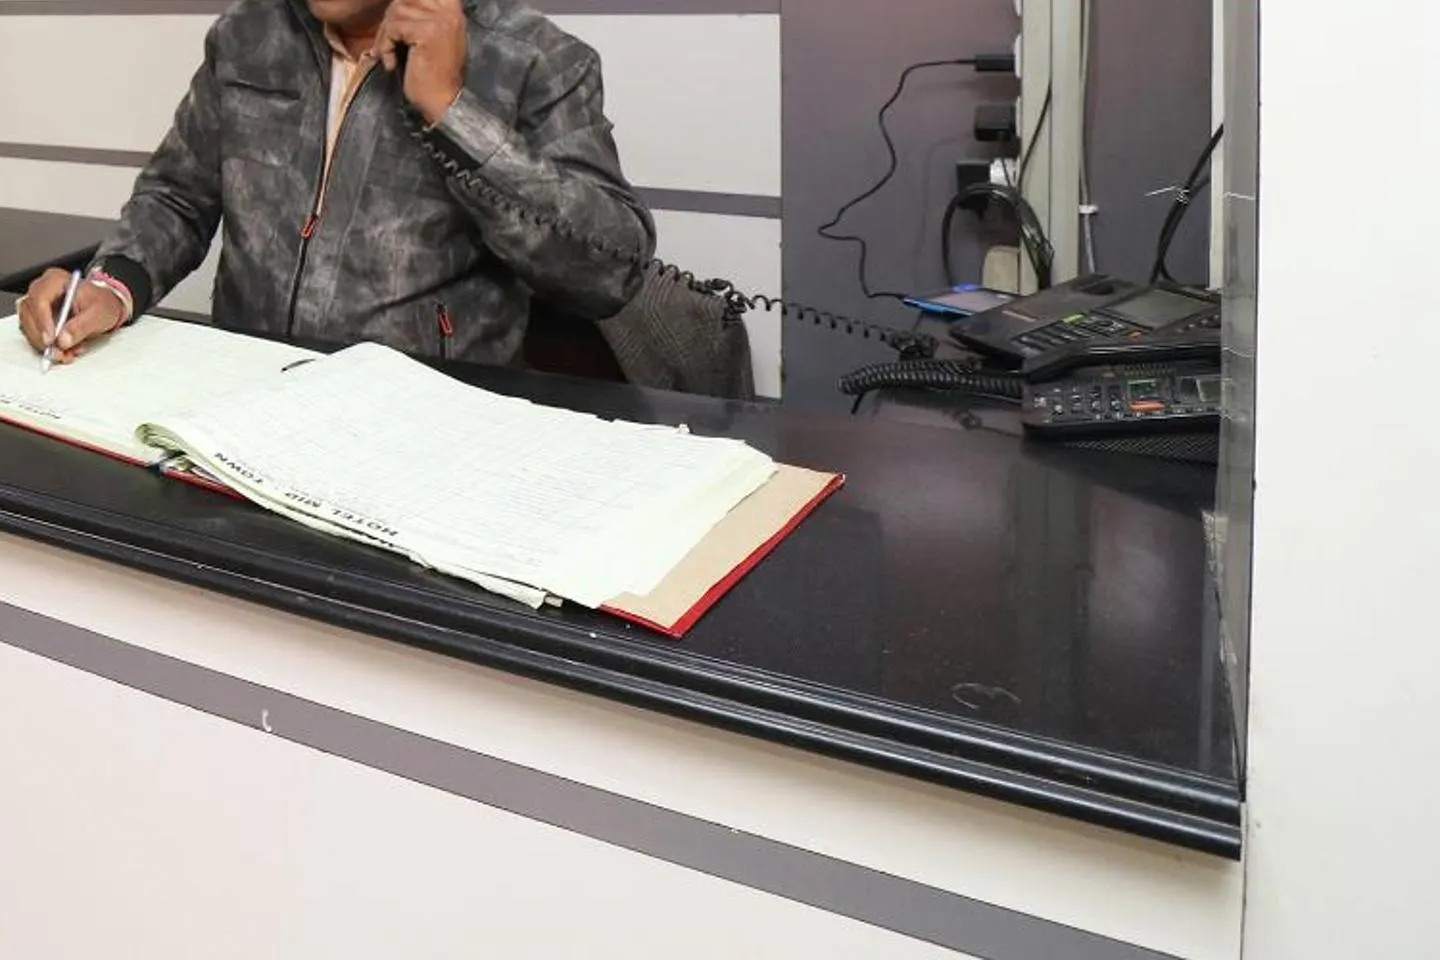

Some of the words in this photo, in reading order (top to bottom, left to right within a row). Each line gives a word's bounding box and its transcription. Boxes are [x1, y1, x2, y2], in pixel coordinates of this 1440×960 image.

[214, 452, 264, 484] TOWN
[285, 492, 322, 508] MID
[331, 508, 399, 537] HOTEL
